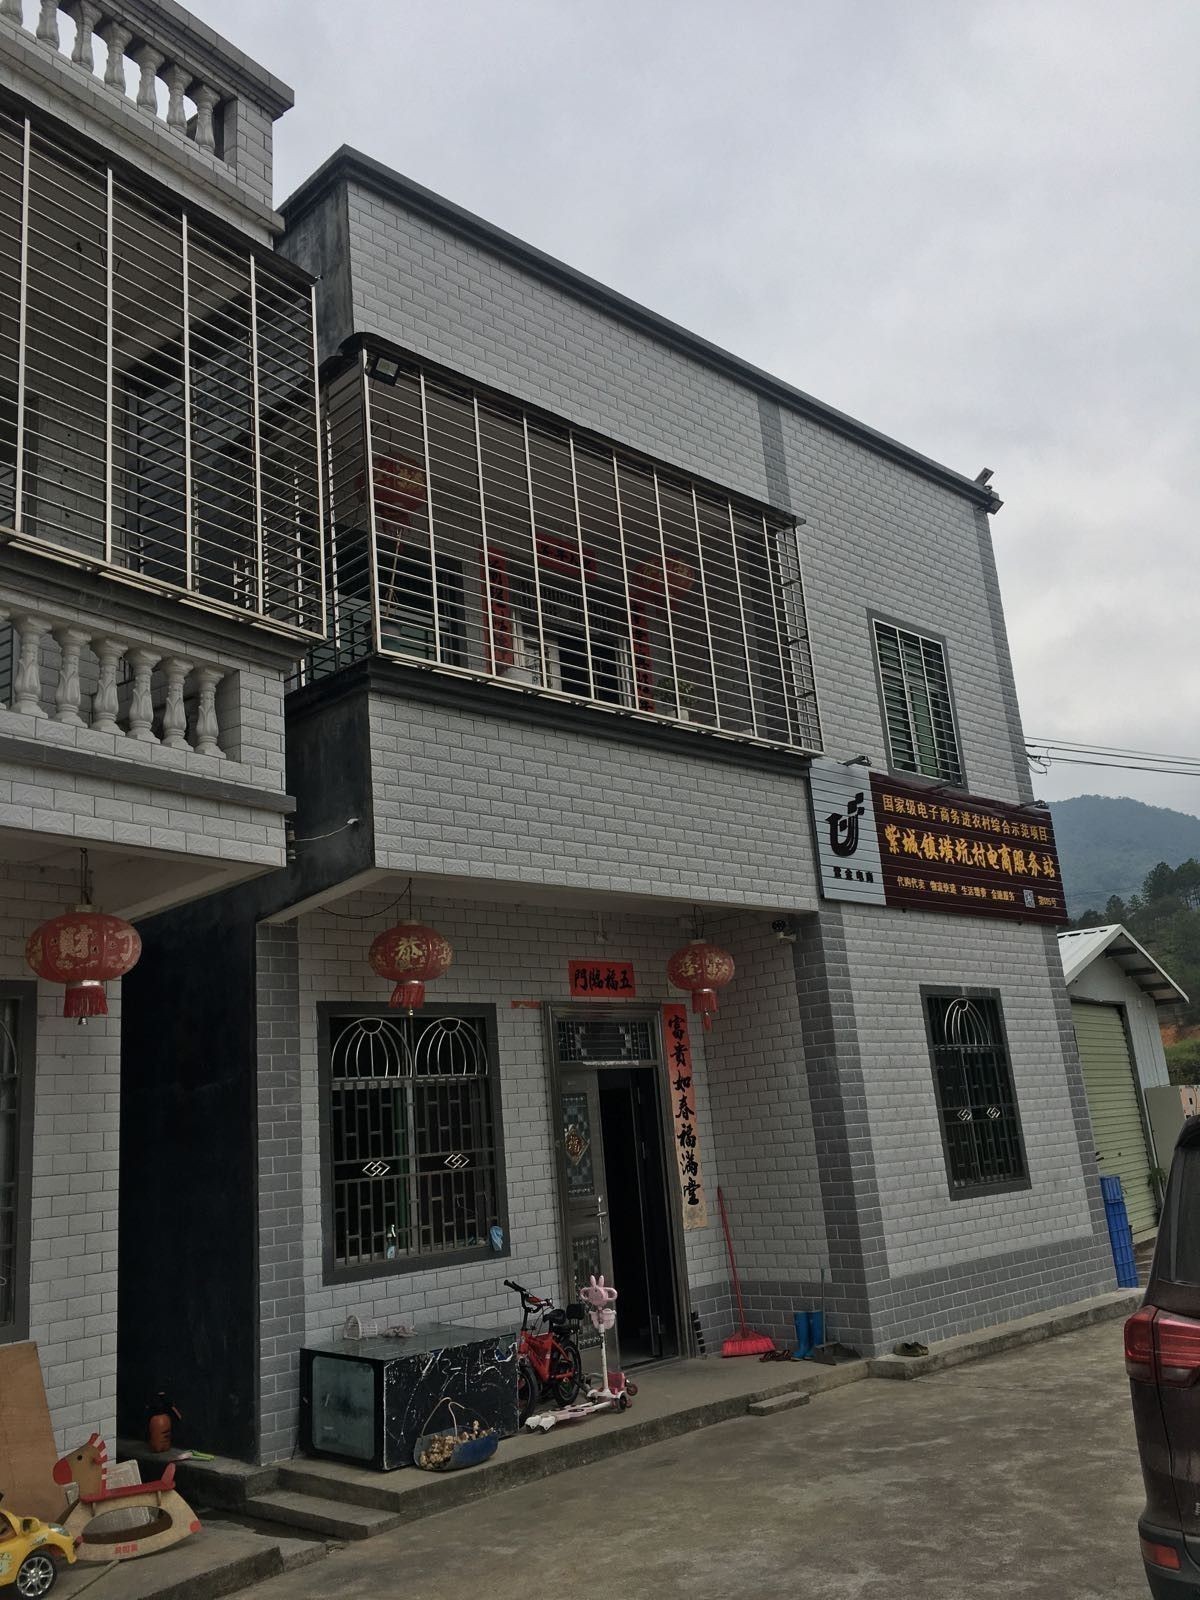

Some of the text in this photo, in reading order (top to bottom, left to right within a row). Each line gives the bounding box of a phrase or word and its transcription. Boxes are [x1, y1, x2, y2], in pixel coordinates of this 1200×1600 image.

[882, 794, 1048, 842] 国家级电子商务进农村综合示范项目
